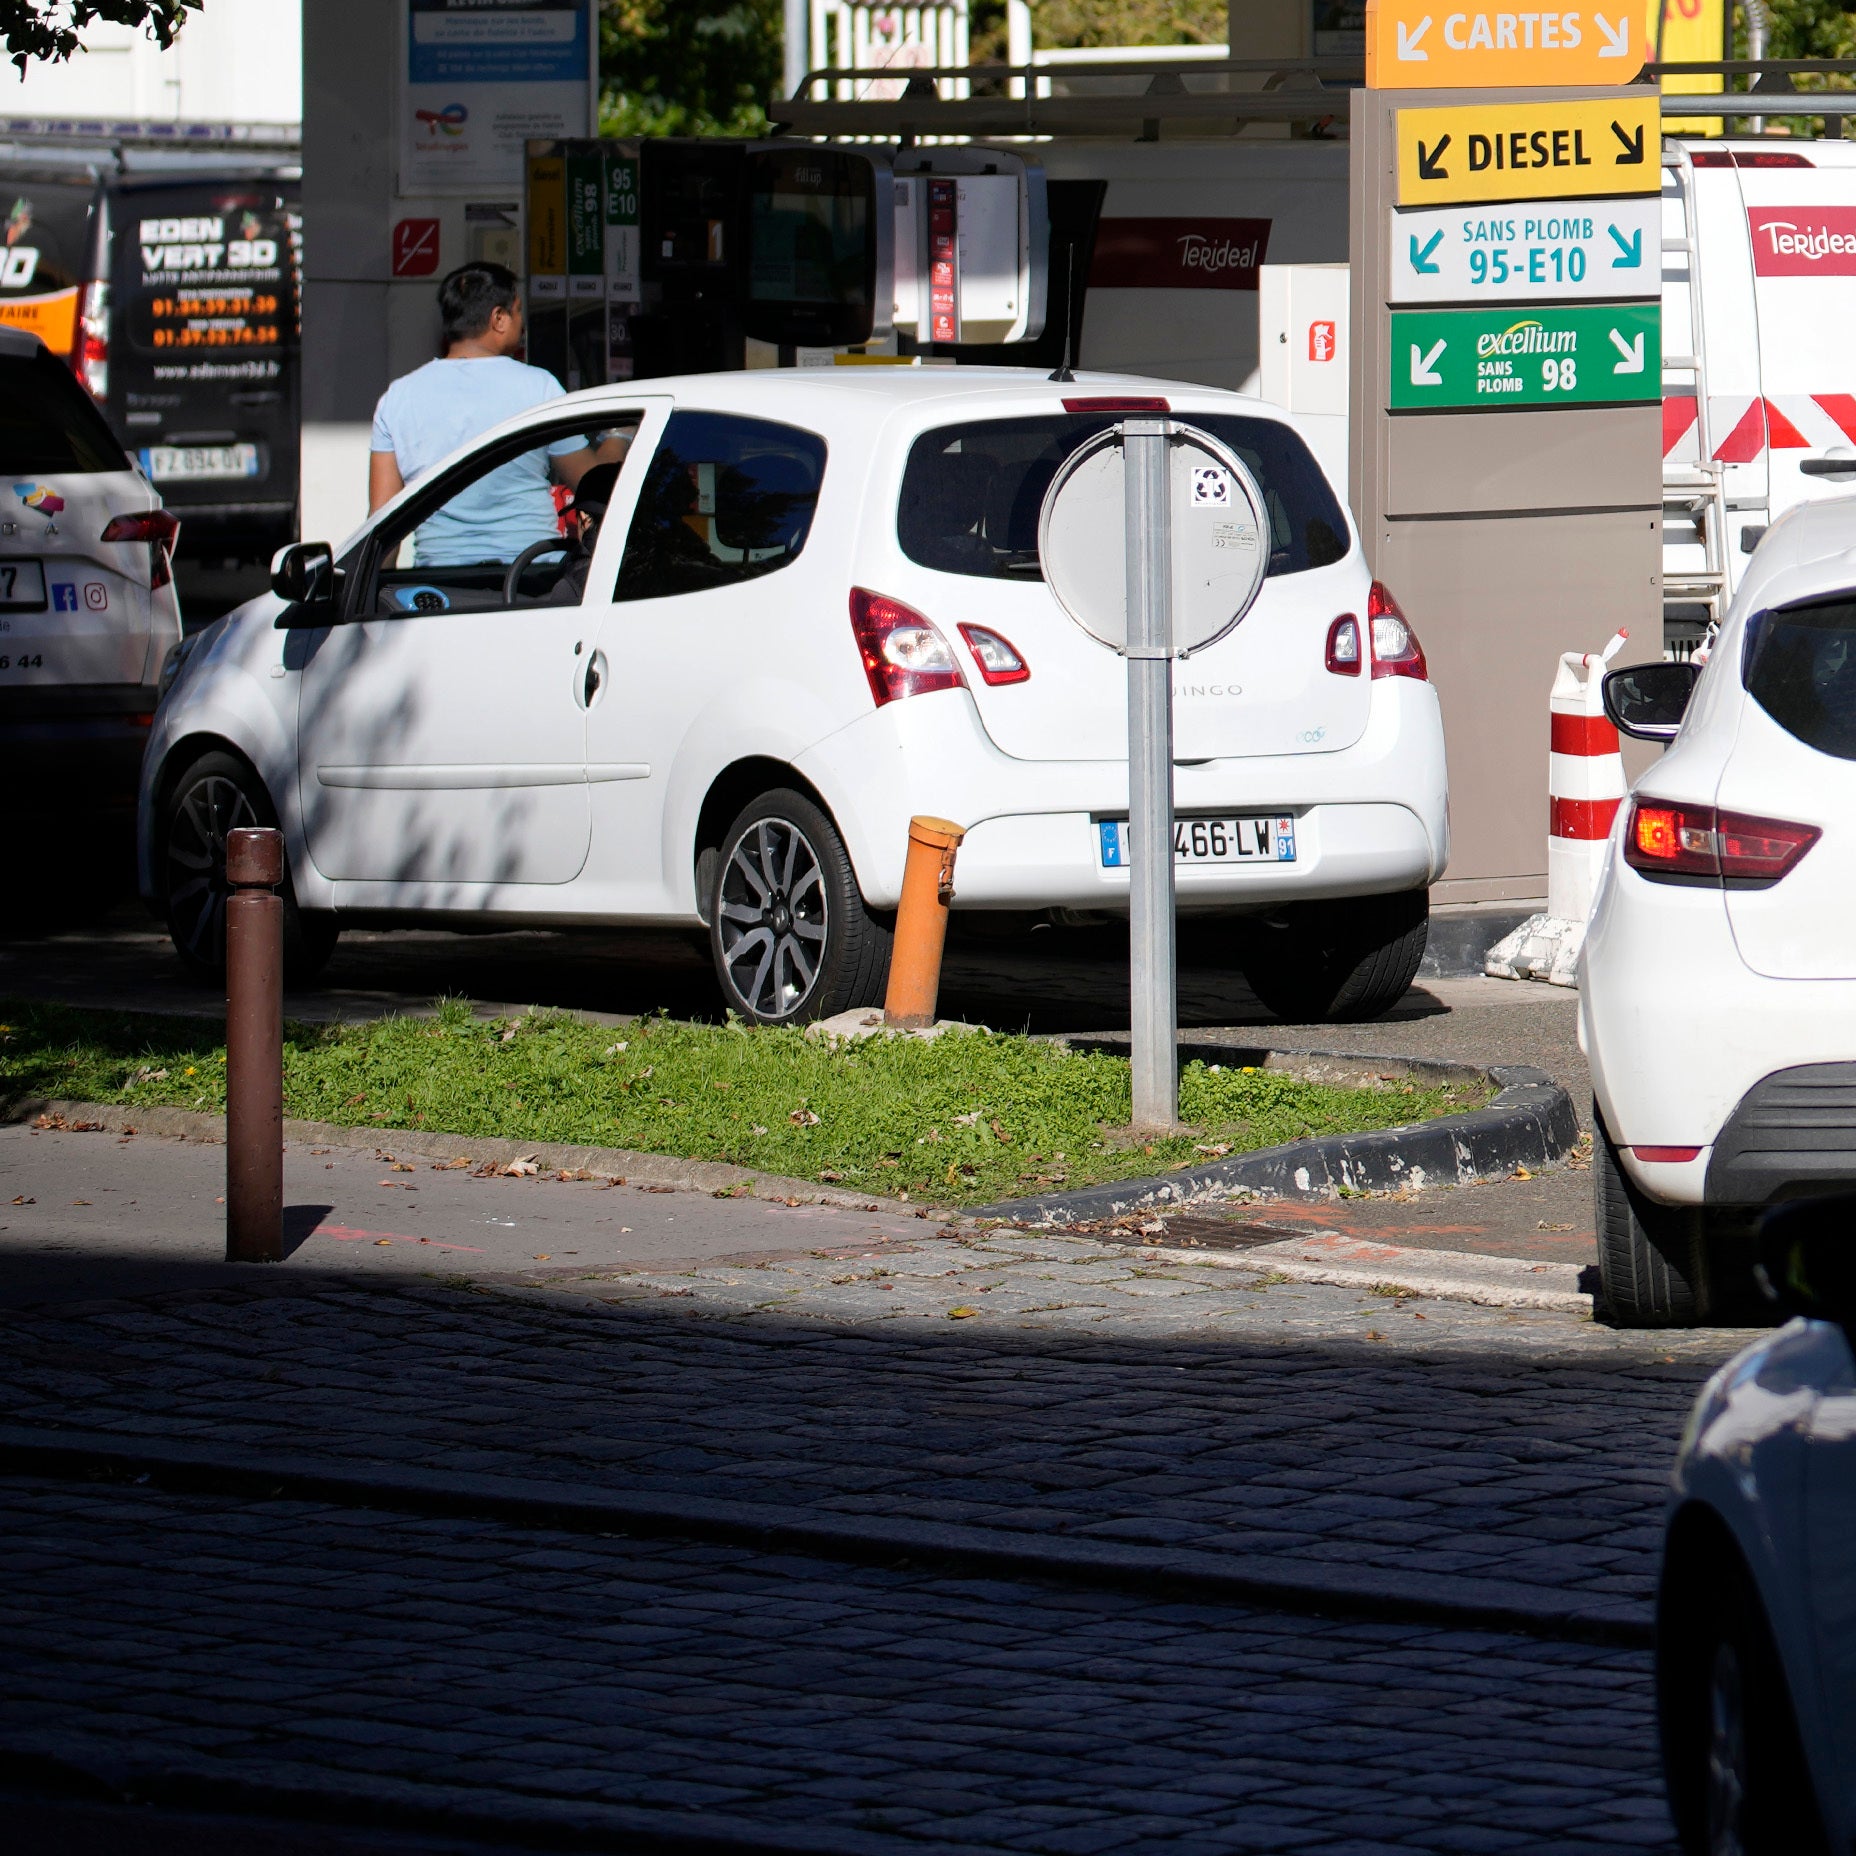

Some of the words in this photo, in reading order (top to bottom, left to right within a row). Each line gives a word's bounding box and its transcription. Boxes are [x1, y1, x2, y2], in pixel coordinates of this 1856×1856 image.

[1444, 11, 1582, 51] CARTES
[1468, 128, 1592, 172] DIESEL
[612, 167, 631, 190] 95
[585, 183, 598, 213] 98
[608, 192, 636, 215] E10
[139, 217, 224, 245] EDEN
[712, 222, 723, 259] 1
[1462, 219, 1516, 243] SANS
[1525, 217, 1594, 242] PLOMB
[142, 243, 225, 271] VERT
[227, 239, 277, 268] 3D
[1469, 246, 1587, 285] 95-E10
[610, 323, 626, 341] 30
[1477, 325, 1578, 359] excellium
[1477, 361, 1514, 377] SANS
[1542, 358, 1577, 392] 98
[1477, 376, 1524, 394] PLOMB
[18, 655, 43, 669] 44
[1108, 847, 1116, 860] F
[1278, 836, 1294, 857] 91
